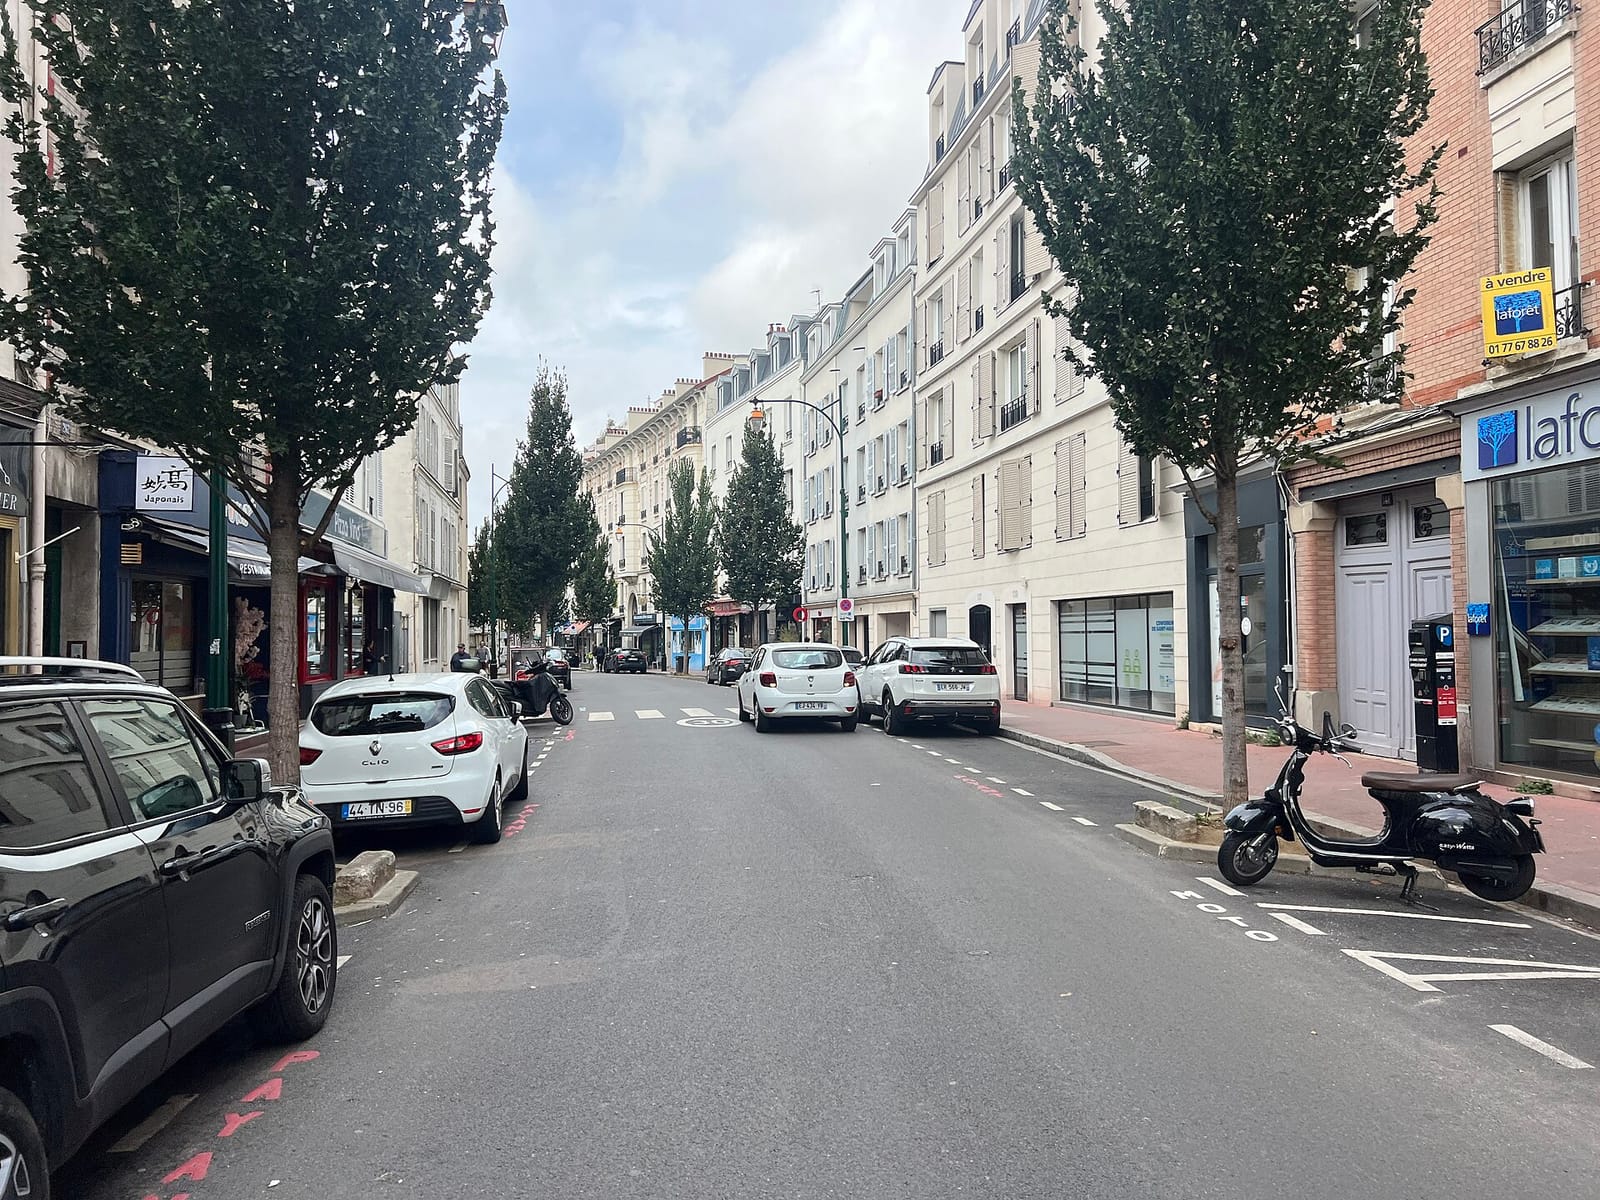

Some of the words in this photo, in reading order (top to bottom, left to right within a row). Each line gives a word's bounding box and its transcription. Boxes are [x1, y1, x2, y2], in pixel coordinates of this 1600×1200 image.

[1485, 278, 1494, 289] à
[1497, 270, 1546, 289] vendre
[1496, 304, 1540, 321] laforêt
[1488, 343, 1500, 354] 01
[1502, 341, 1513, 353] 77
[1515, 340, 1526, 351] 67
[1528, 338, 1540, 350] 88
[1541, 336, 1553, 348] 26
[144, 495, 184, 504] Japonais
[1440, 627, 1450, 643] P
[1169, 890, 1279, 942] MOTO
[143, 1050, 321, 1200] PAYA
